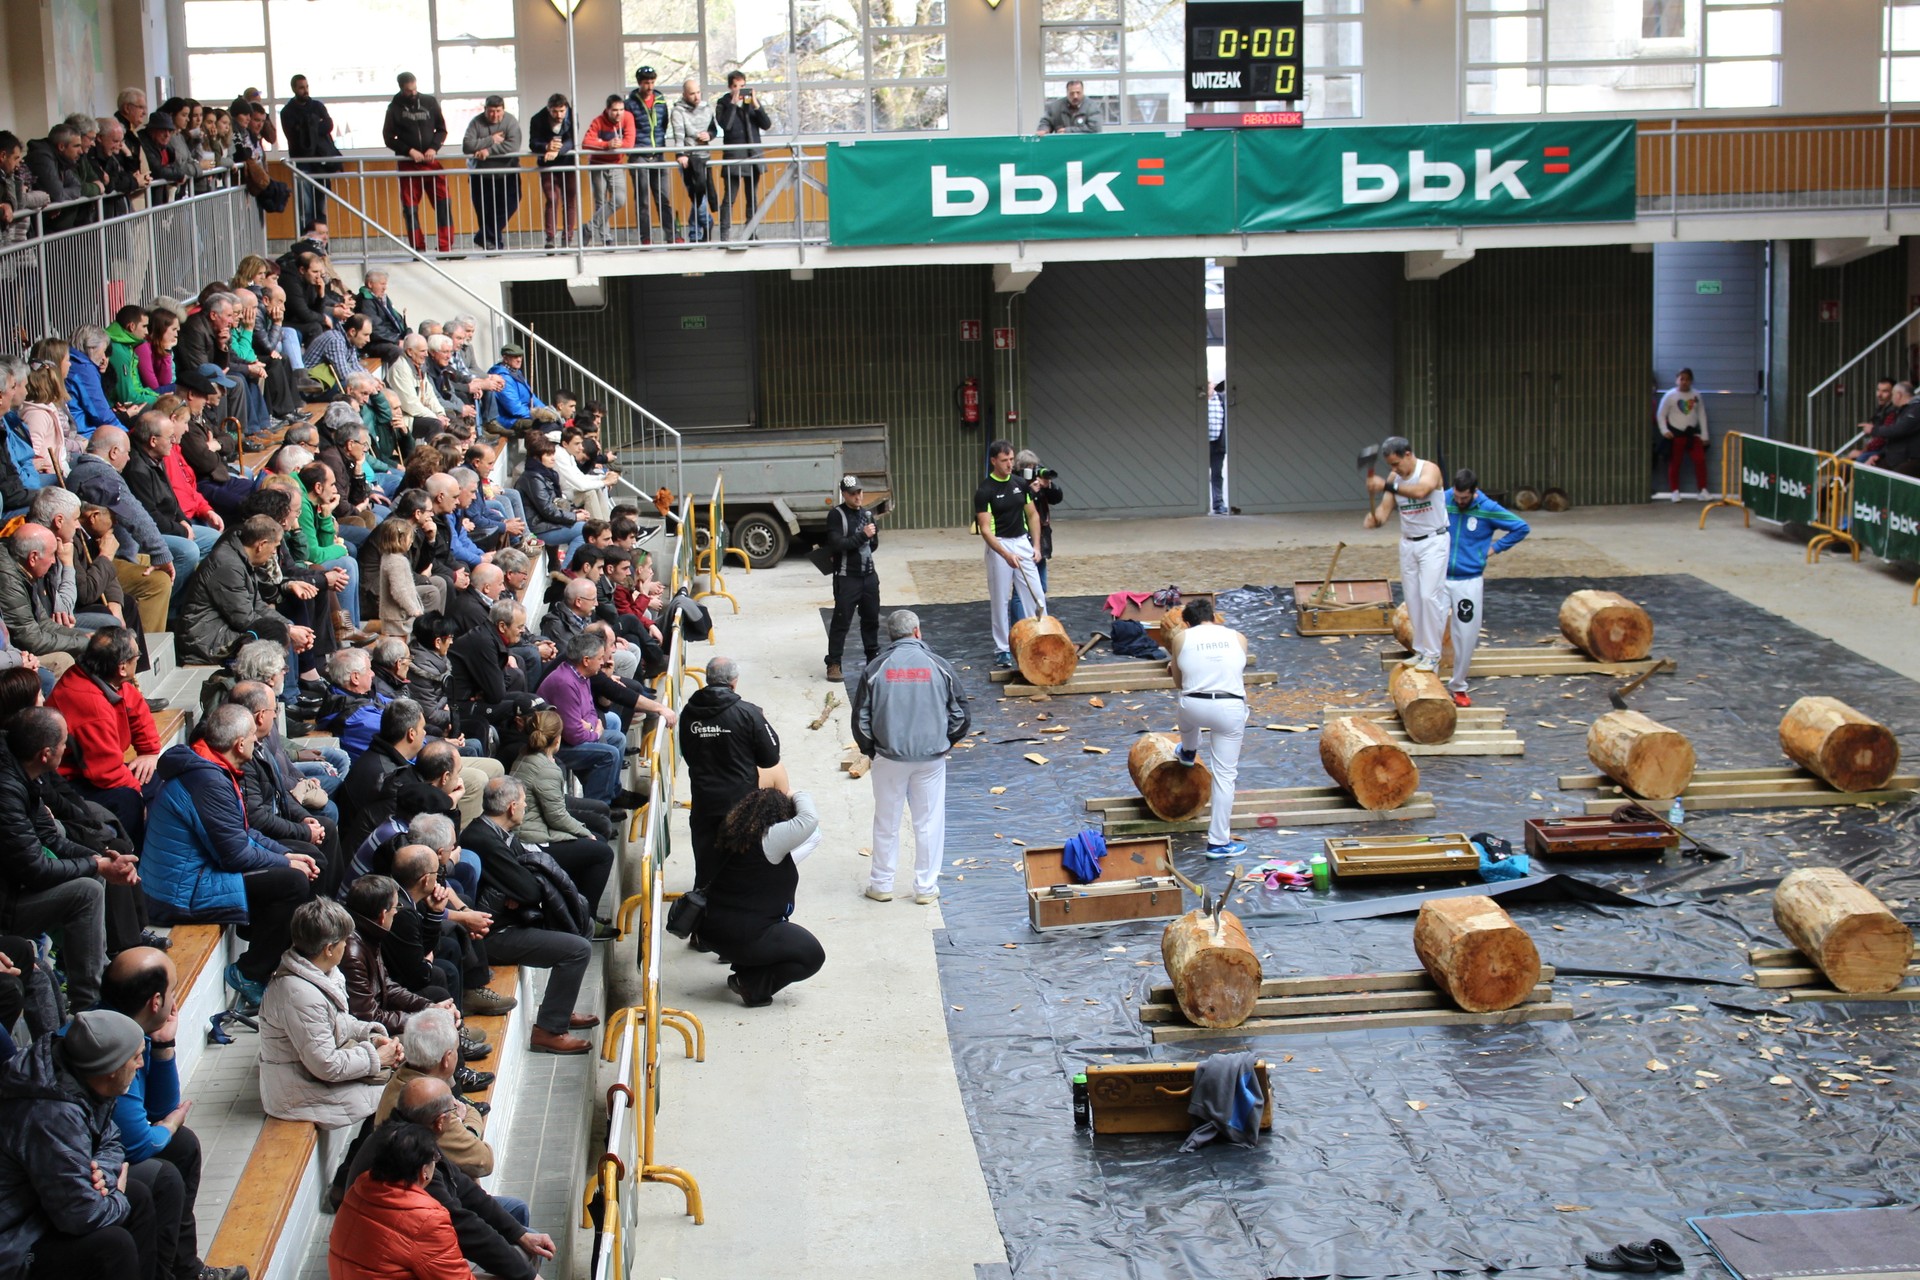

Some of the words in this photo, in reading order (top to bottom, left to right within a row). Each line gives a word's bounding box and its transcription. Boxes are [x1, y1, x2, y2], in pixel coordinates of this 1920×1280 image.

[1218, 28, 1296, 58] 0:00
[1192, 71, 1242, 89] UNTZEAK
[1275, 65, 1296, 94] 0
[931, 161, 1125, 217] bbk
[1342, 149, 1532, 204] bbk
[1743, 466, 1769, 490] bbk
[1779, 476, 1807, 499] bbk
[1854, 501, 1881, 525] bbk
[1890, 511, 1918, 536] bbk
